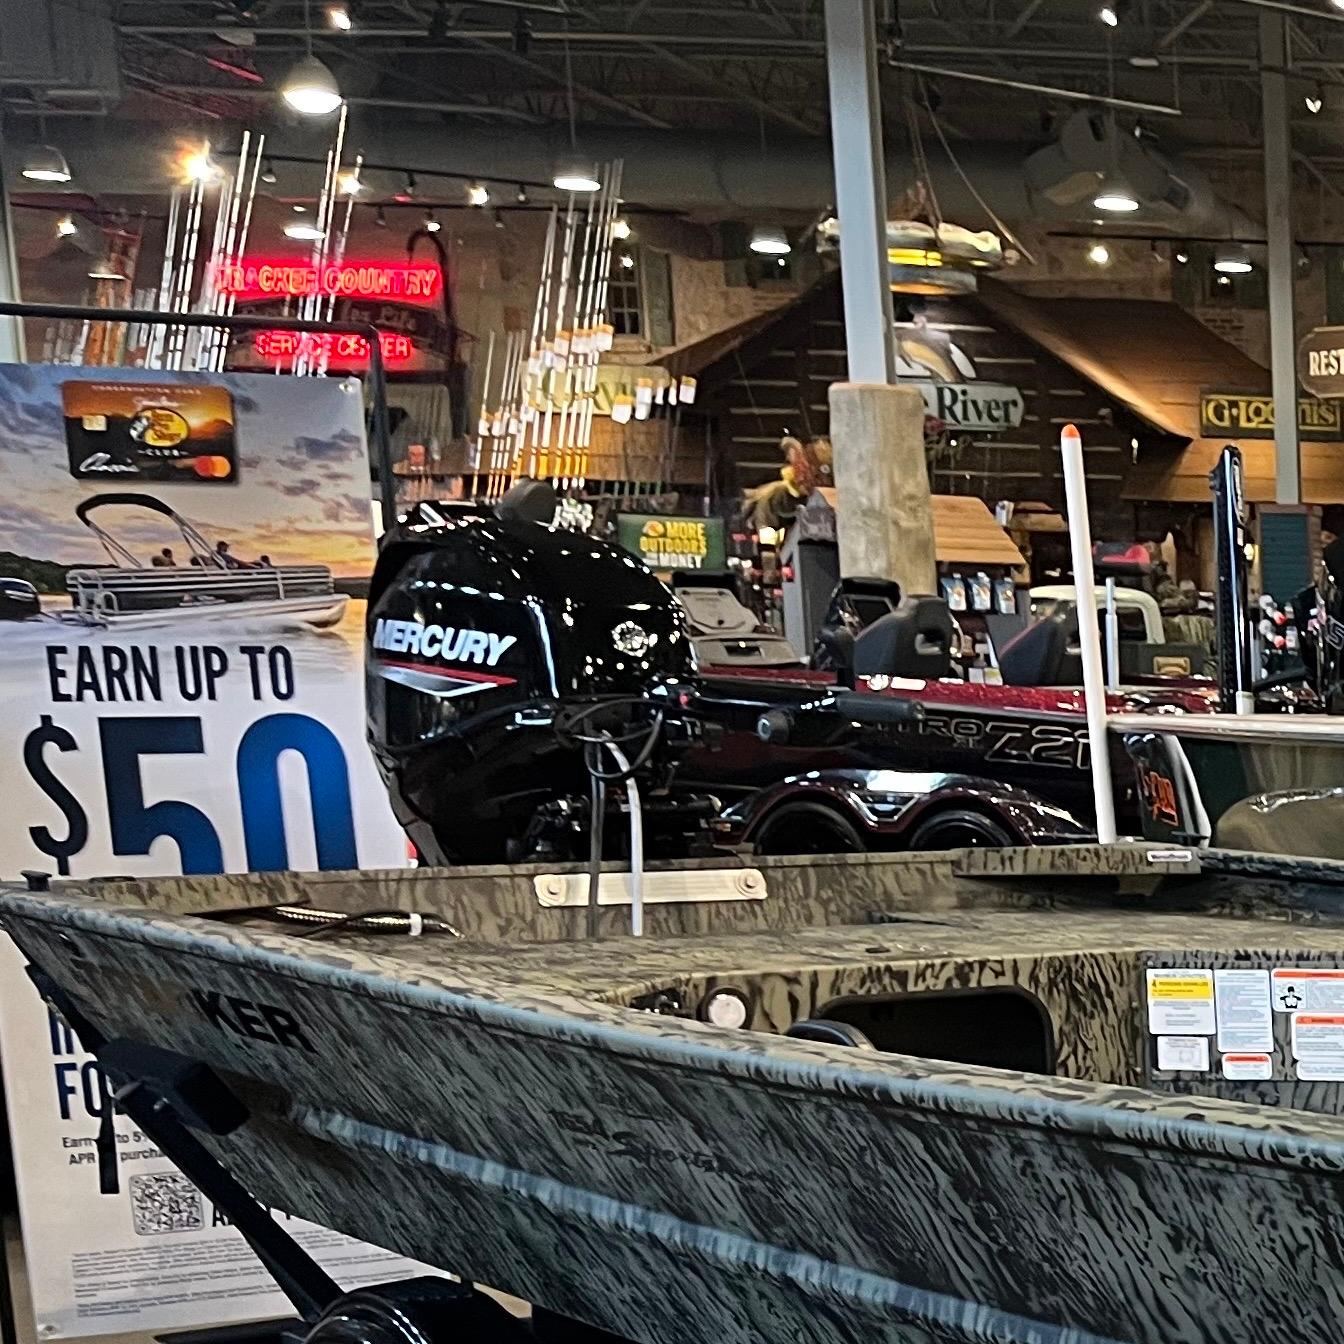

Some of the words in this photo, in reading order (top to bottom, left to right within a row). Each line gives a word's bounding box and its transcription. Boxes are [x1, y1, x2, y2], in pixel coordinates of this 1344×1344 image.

[936, 386, 1018, 425] River
[665, 521, 705, 539] MORE
[373, 618, 517, 666] MERCURY
[46, 645, 162, 702] EARN
[175, 645, 229, 701] UP
[240, 645, 294, 700] TO
[23, 713, 359, 876] $50
[69, 1152, 95, 1166] APR
